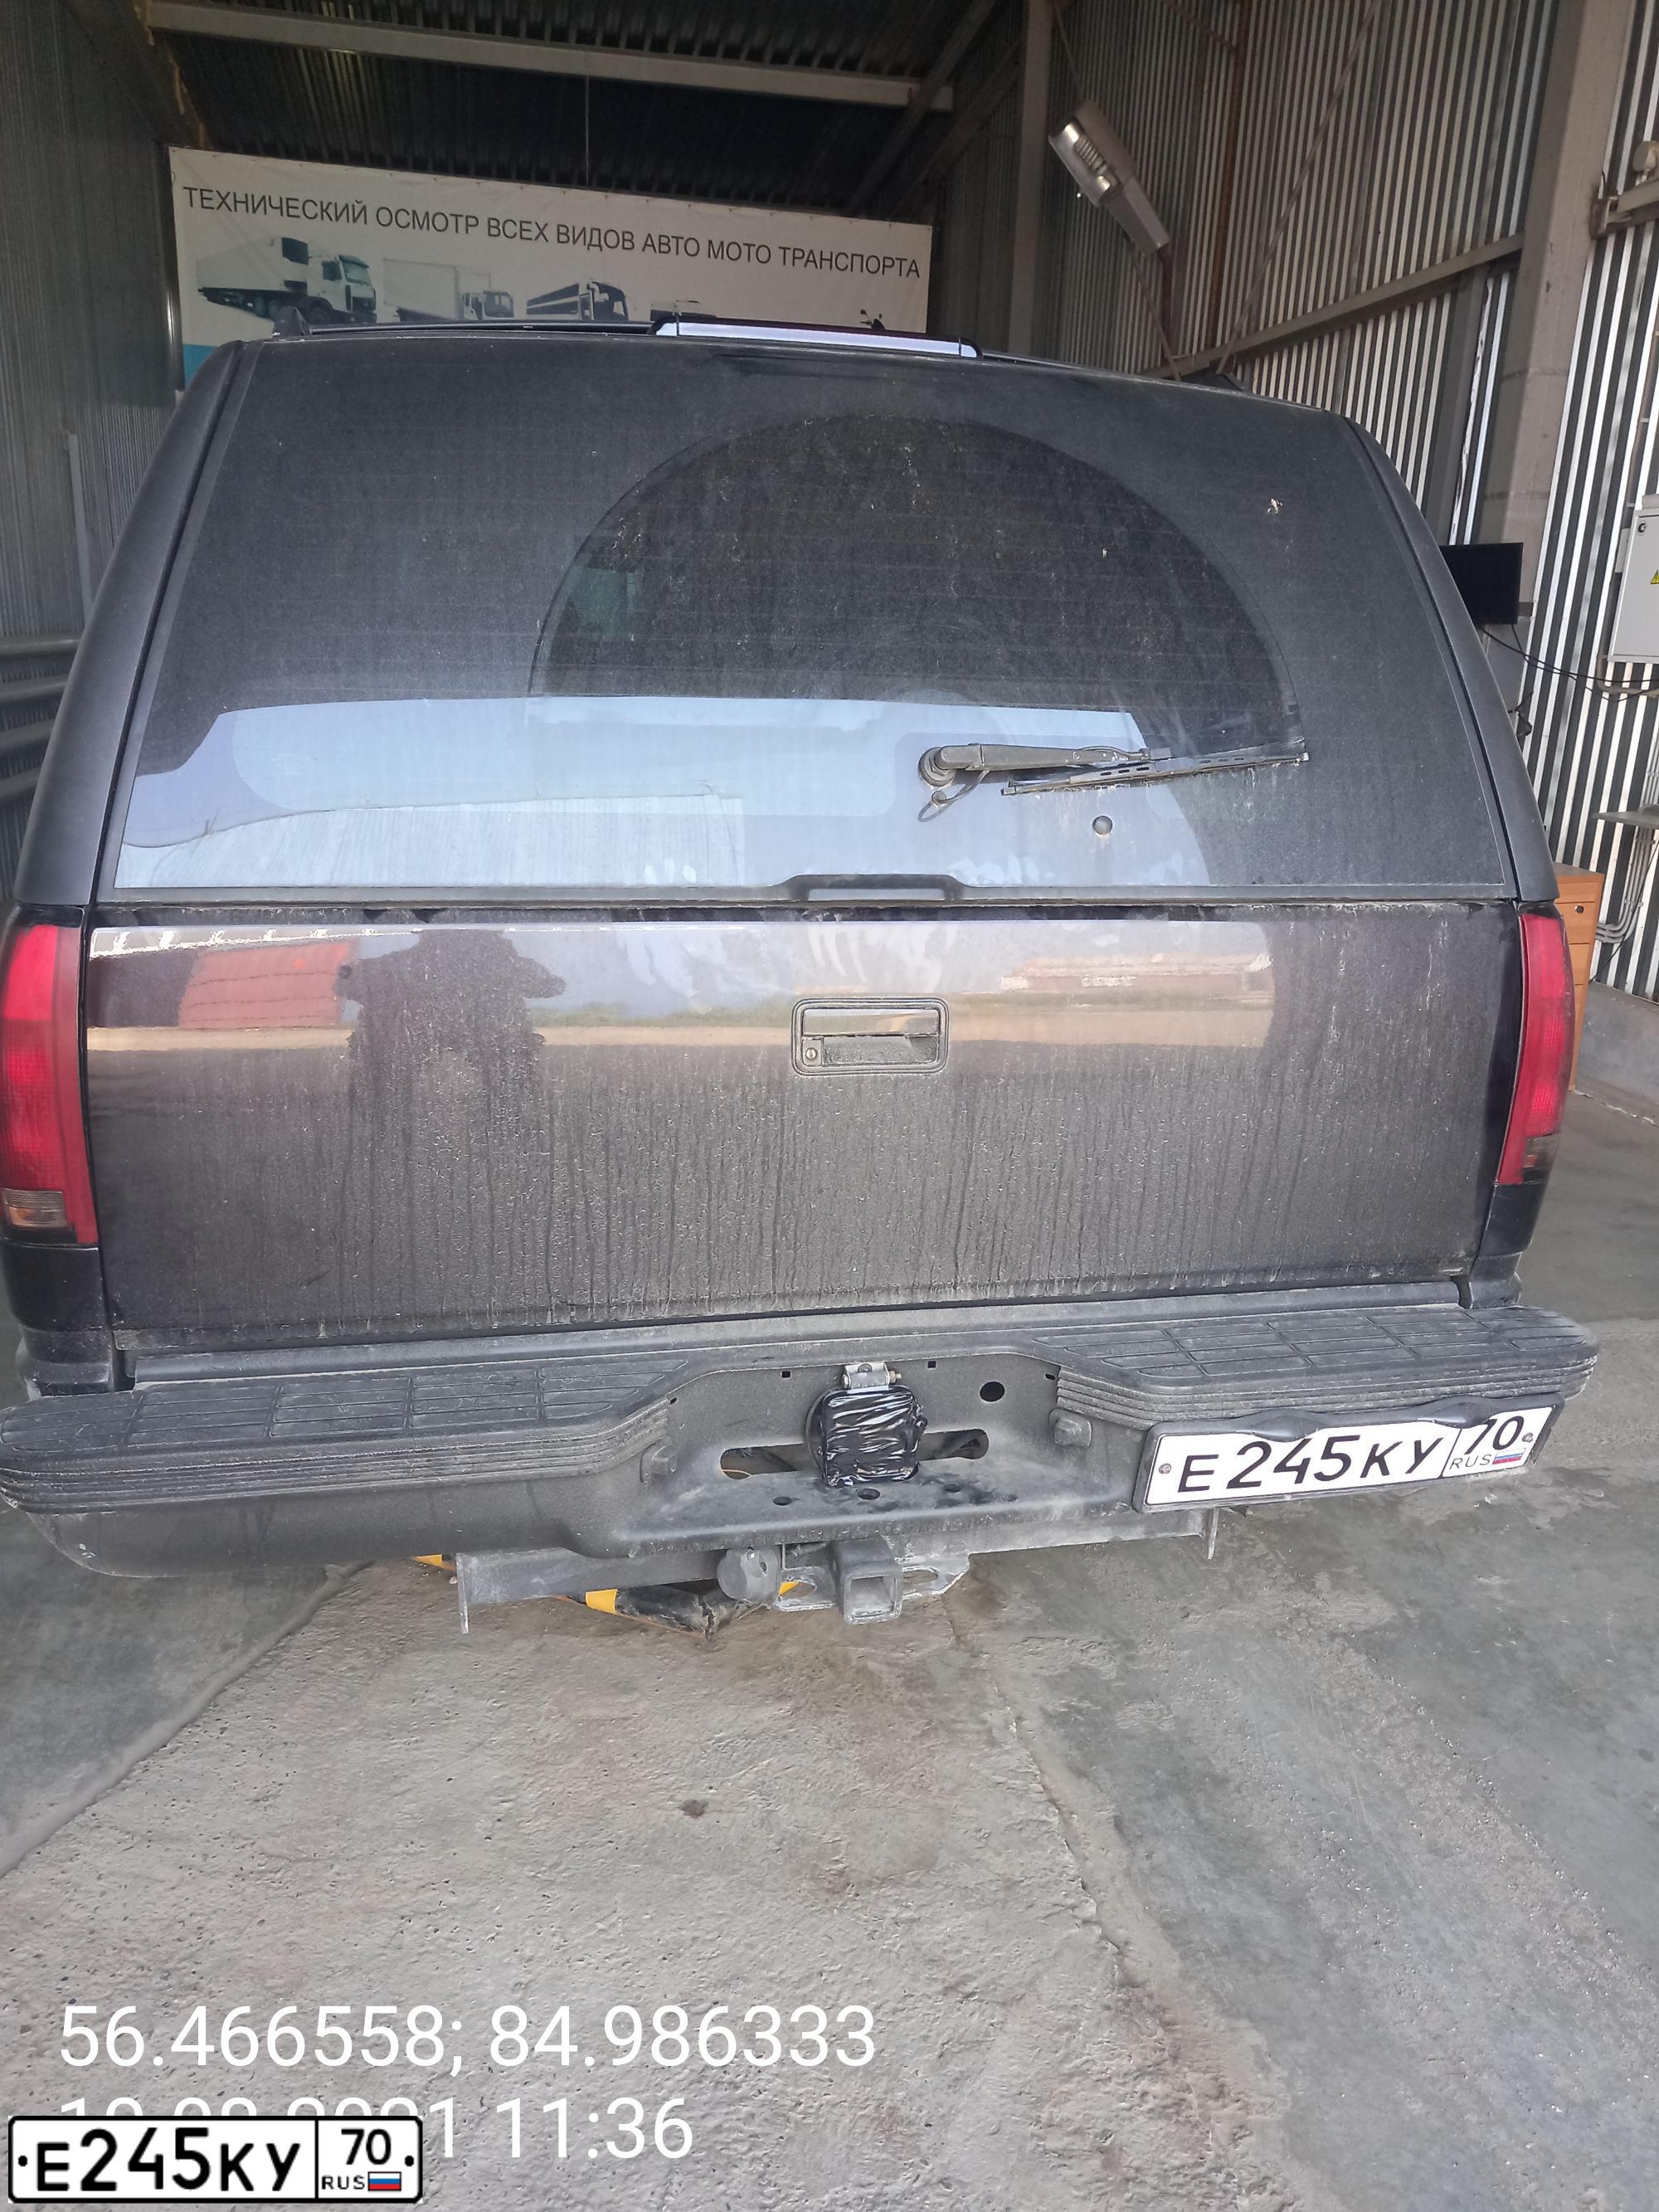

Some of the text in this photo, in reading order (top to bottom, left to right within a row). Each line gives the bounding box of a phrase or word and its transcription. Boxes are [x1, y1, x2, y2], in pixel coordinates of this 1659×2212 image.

[182, 186, 920, 279] ТЕХНИЧЕСКИЙ ОСМОТР ВСЕХ ВИДОВ АВТО МОТО ТРАНСПОРТА
[1464, 1415, 1523, 1455] 70
[1449, 1453, 1493, 1470] RUS
